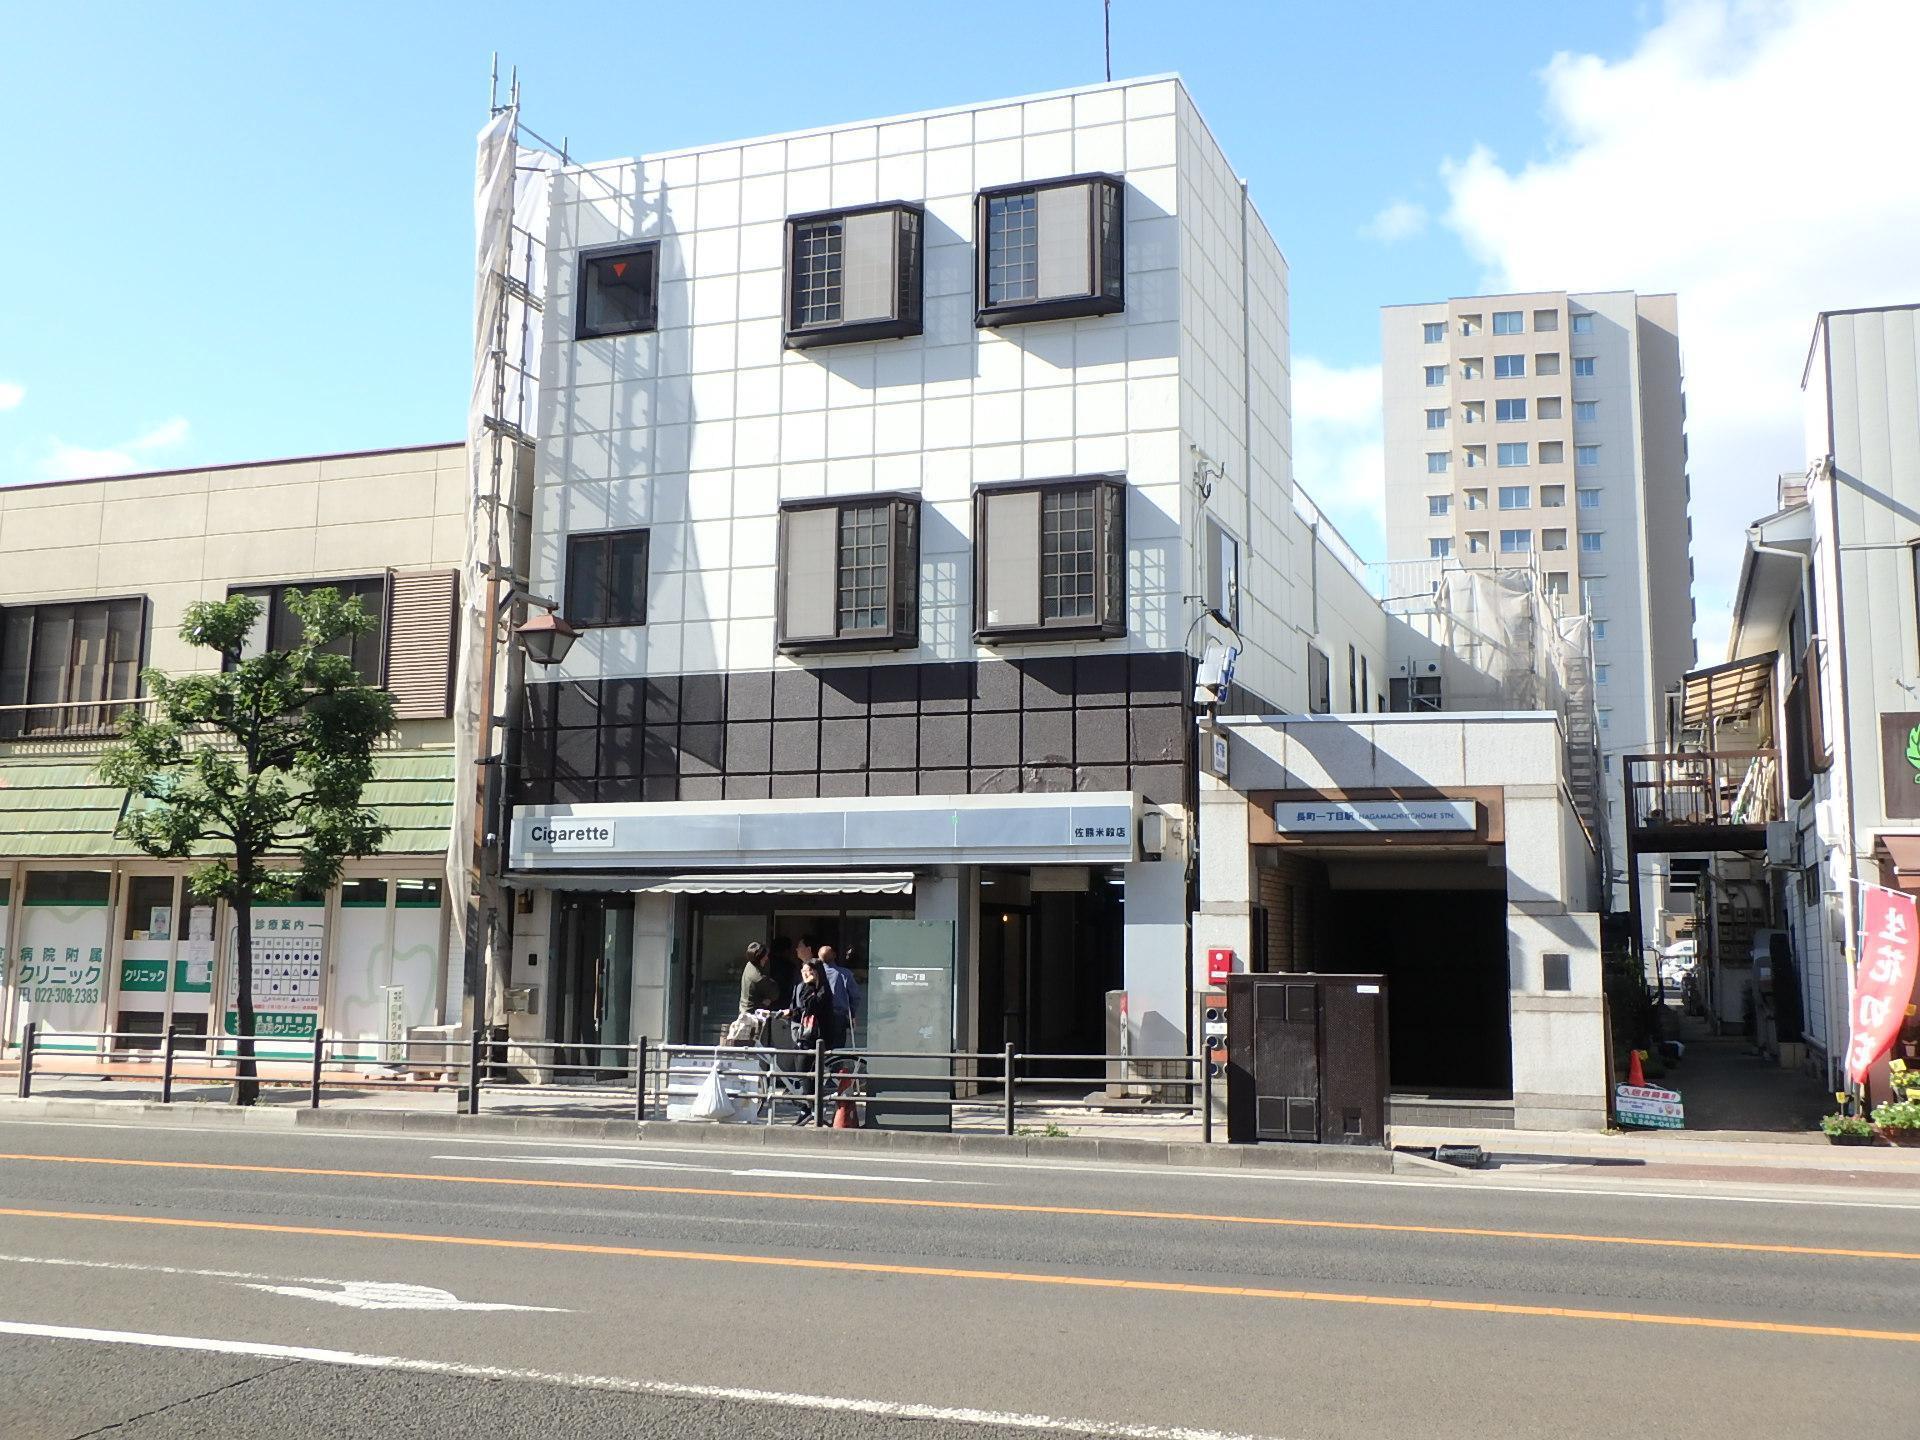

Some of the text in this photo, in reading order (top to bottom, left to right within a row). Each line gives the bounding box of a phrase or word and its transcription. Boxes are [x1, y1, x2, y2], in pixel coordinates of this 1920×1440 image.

[1296, 811, 1355, 821] 長町一丁目駅
[531, 826, 609, 844] Cigarette
[254, 918, 305, 931] 診療案内
[20, 947, 103, 963] 病院附属
[19, 965, 101, 985] クリニック
[125, 969, 165, 982] クリニック
[895, 973, 926, 981] 長町一丁目
[35, 987, 99, 1004] 022-308-2383
